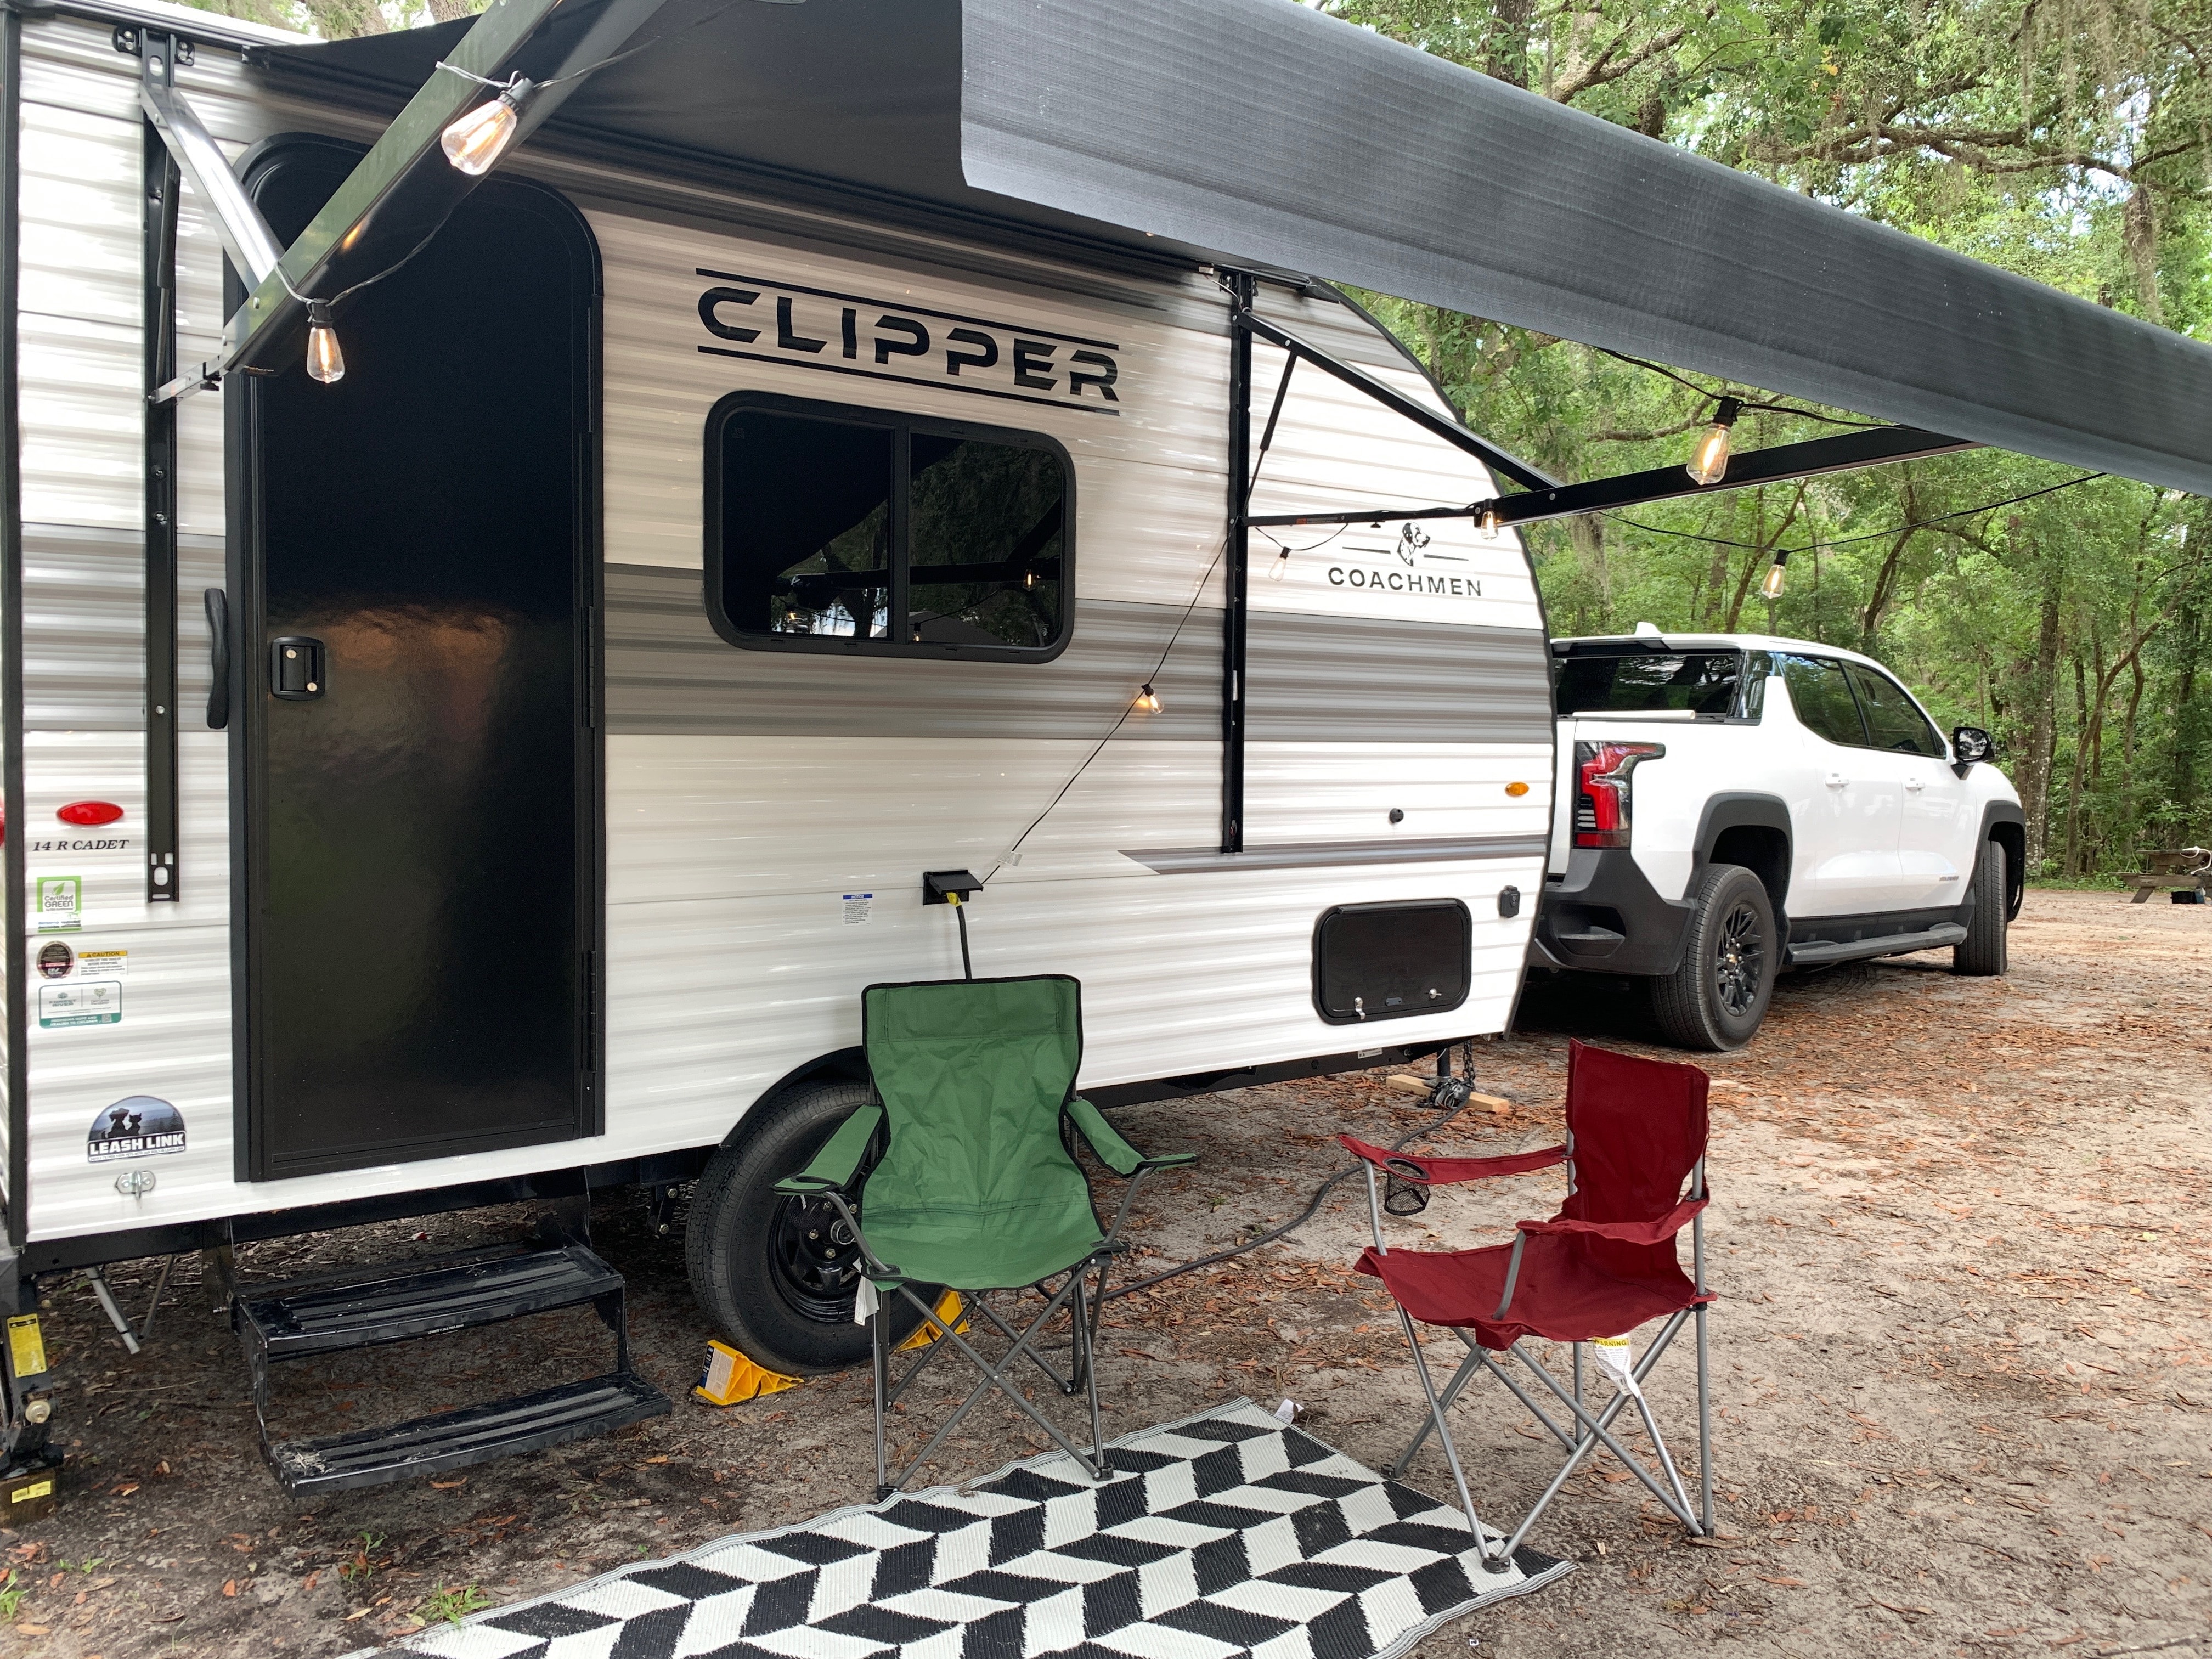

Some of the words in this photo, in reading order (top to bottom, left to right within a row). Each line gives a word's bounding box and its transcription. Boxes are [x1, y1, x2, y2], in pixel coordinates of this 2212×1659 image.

[698, 286, 1120, 402] CLIPPER
[1328, 567, 1482, 596] COACHMEN
[32, 842, 51, 851] 14
[57, 841, 68, 850] R
[72, 839, 129, 850] CADET
[89, 1138, 143, 1155] LEASH
[146, 1133, 184, 1149] LINK
